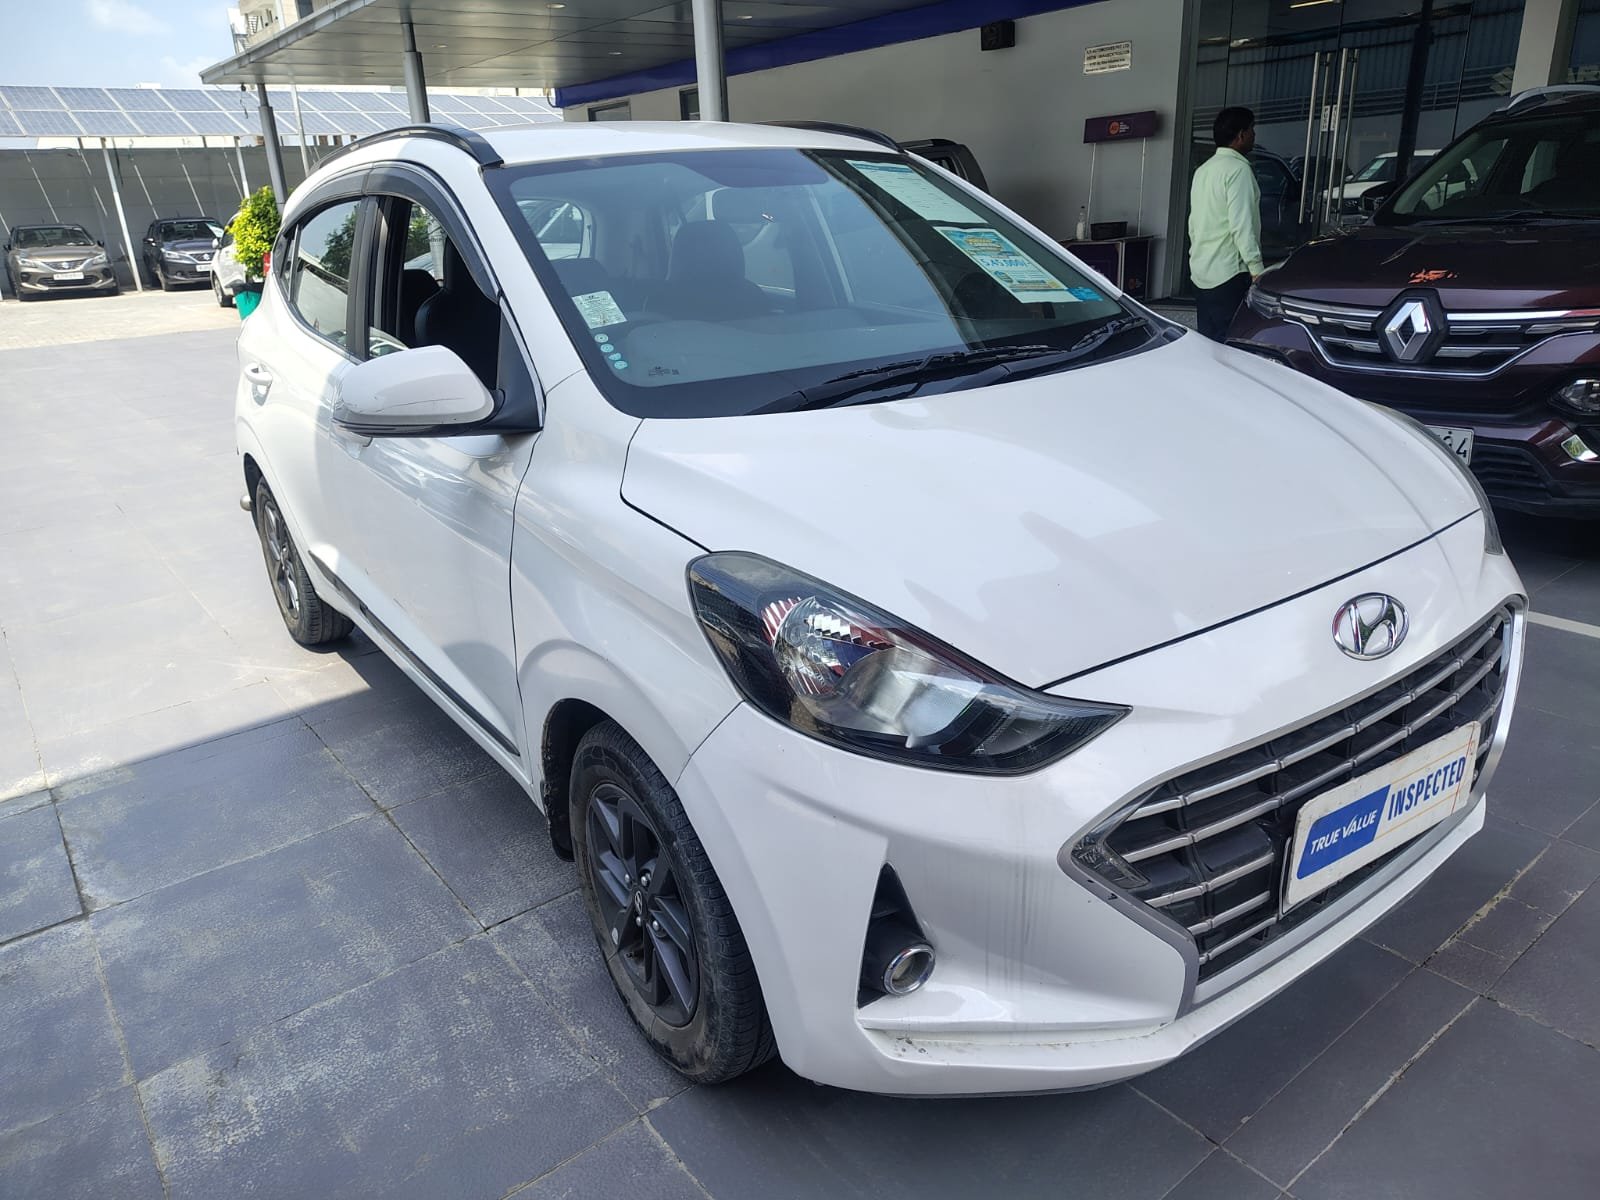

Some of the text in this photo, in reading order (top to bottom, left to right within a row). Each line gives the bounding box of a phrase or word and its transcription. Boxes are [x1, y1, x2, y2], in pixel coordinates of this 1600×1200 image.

[1310, 756, 1467, 855] TRUE VALUE INSPECTED
